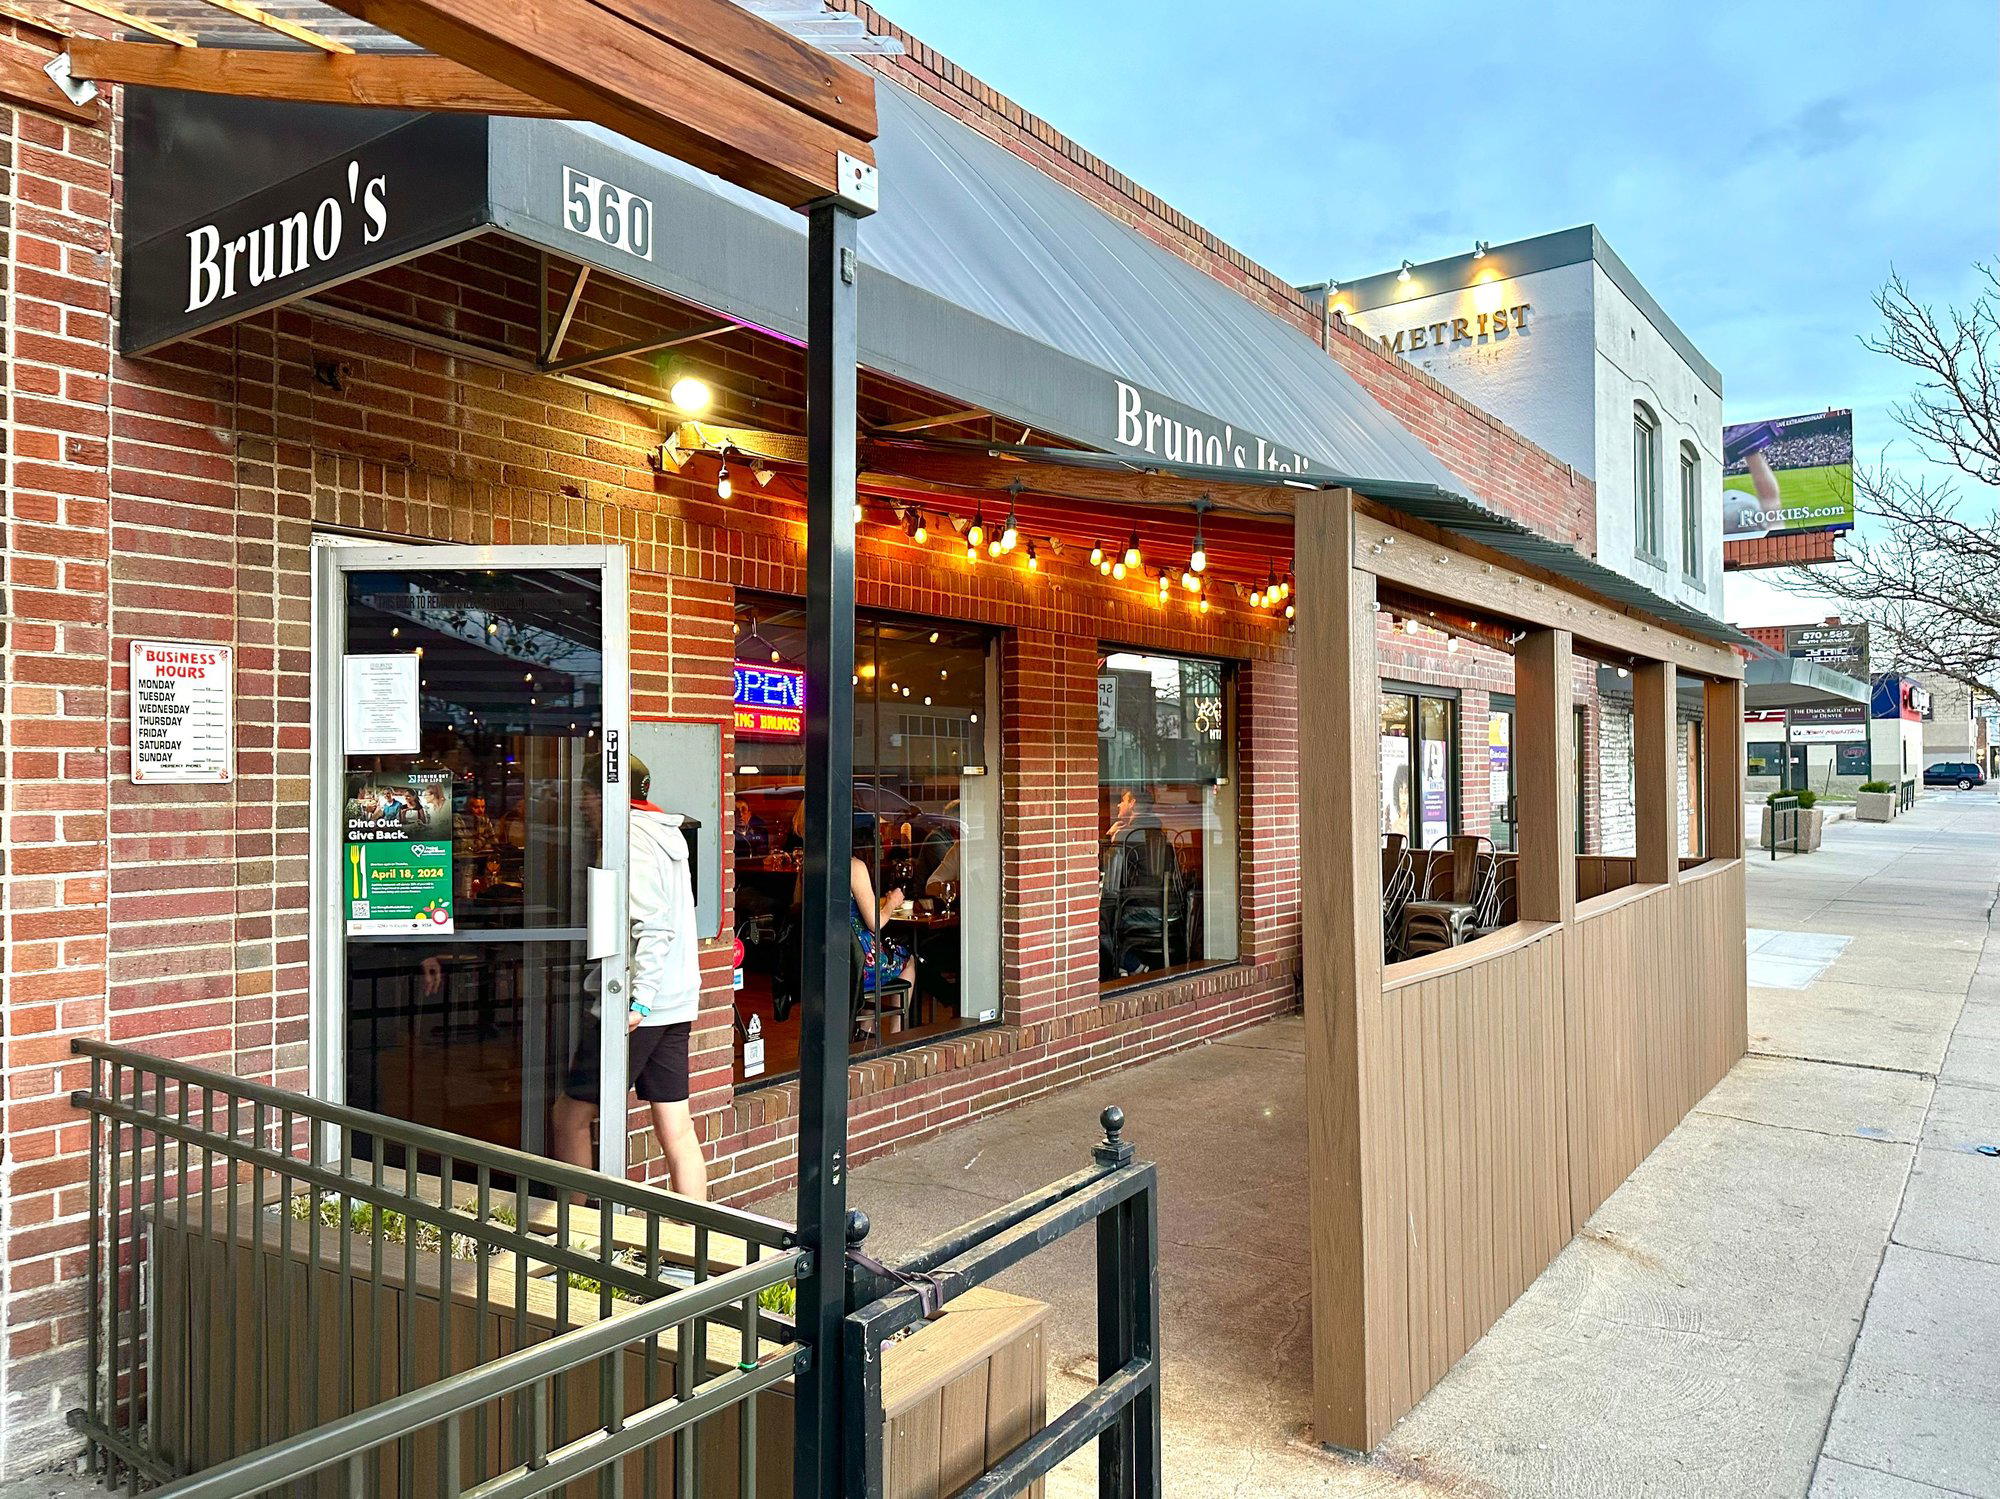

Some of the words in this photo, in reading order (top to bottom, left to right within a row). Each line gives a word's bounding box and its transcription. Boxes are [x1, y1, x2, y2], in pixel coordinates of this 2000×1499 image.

[566, 169, 651, 260] 560
[185, 160, 388, 314] Bruno's
[1380, 303, 1531, 354] METRIST
[1114, 379, 1247, 469] Bruno's
[1737, 505, 1845, 528] ROCKIES.com
[156, 665, 206, 679] HOURS
[138, 679, 176, 690] MONDAY
[138, 691, 176, 702] TUESDAY
[138, 703, 190, 714] WEDNESDAY
[138, 716, 182, 726] THURSDAY
[760, 714, 800, 733] BRUNOS
[138, 728, 168, 738] FRIDAY
[139, 740, 182, 750] SATURDAY
[139, 752, 173, 762] SUNDAY
[607, 731, 618, 773] PULL
[348, 819, 375, 829] Dine
[376, 818, 403, 828] Out.
[348, 830, 375, 840] Give
[376, 829, 409, 840] Back.
[371, 868, 396, 881] April
[399, 869, 415, 879] 18,
[417, 868, 444, 878] 2024
